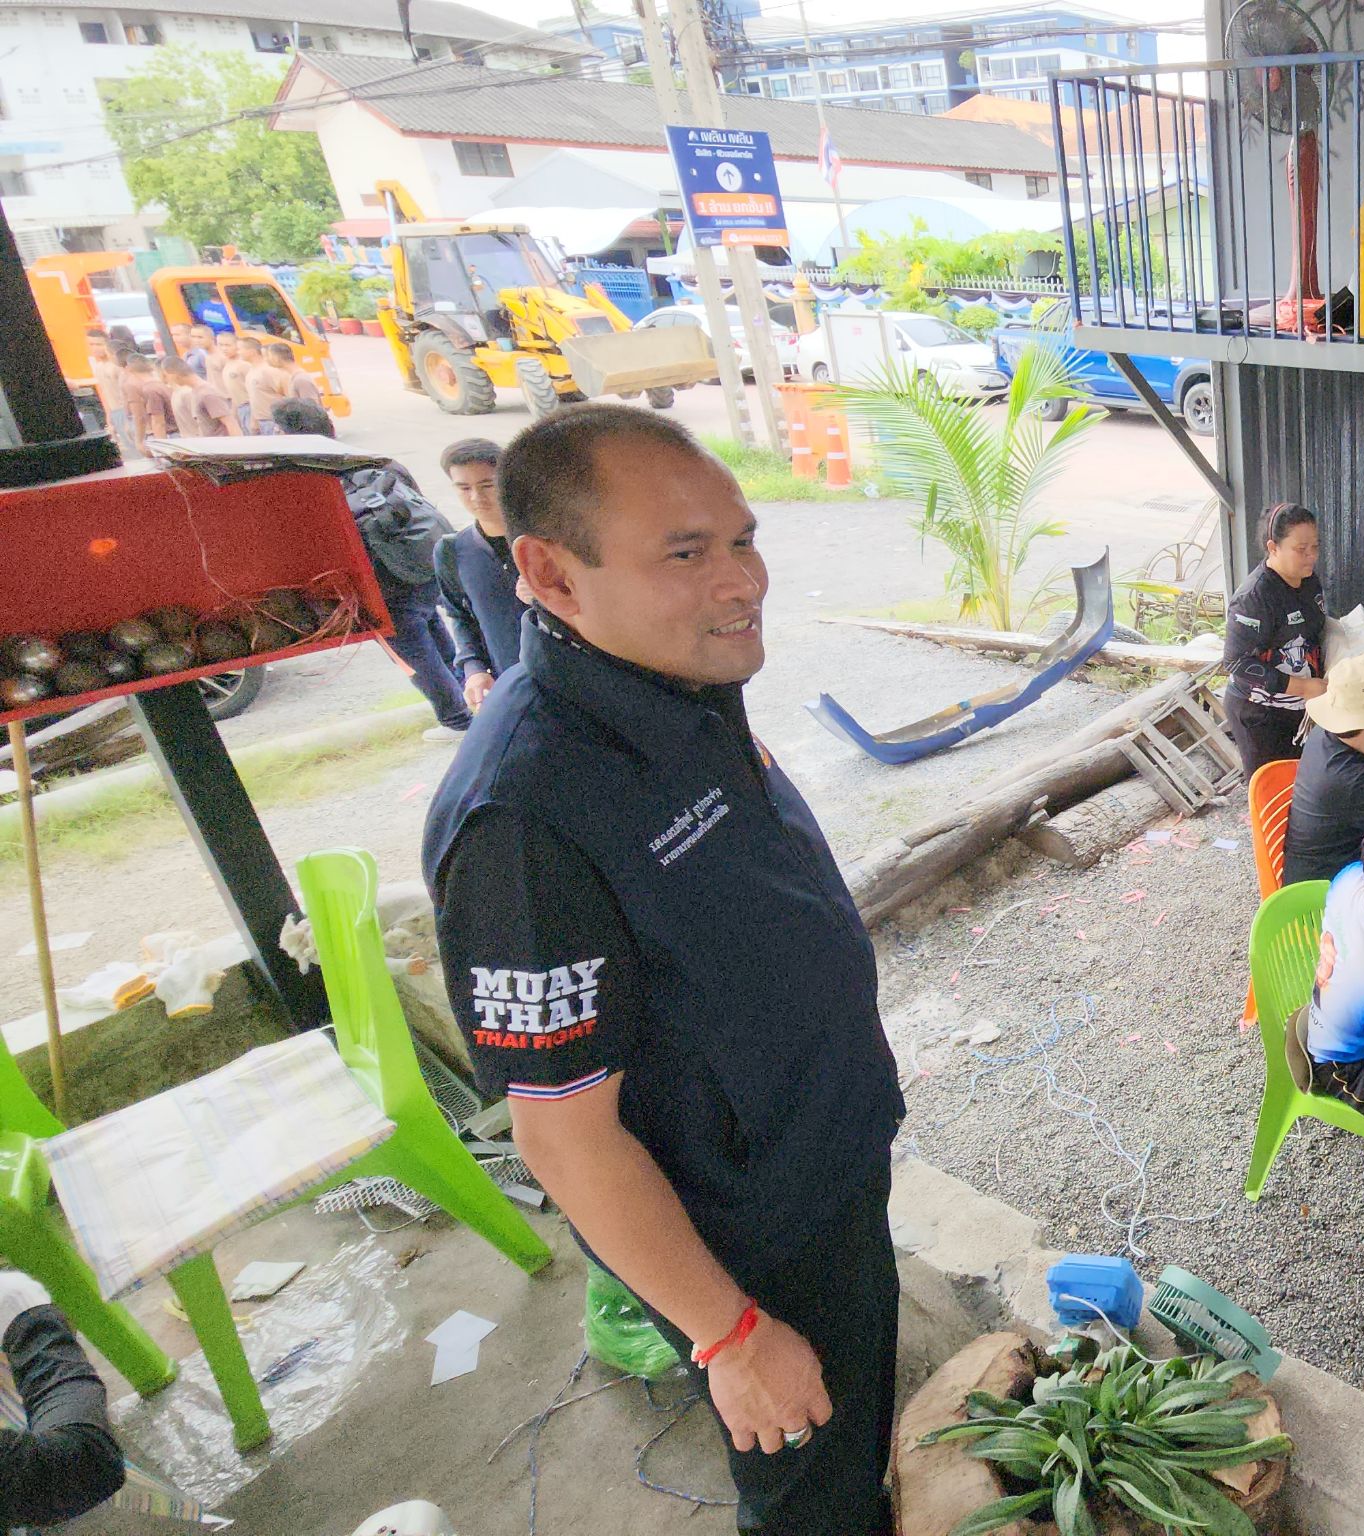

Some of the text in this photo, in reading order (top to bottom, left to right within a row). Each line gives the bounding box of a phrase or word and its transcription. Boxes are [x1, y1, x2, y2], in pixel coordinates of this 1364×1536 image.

[470, 957, 605, 1003] MUAY
[474, 988, 598, 1034] THAI
[473, 1019, 597, 1050] THAI FIGHT
